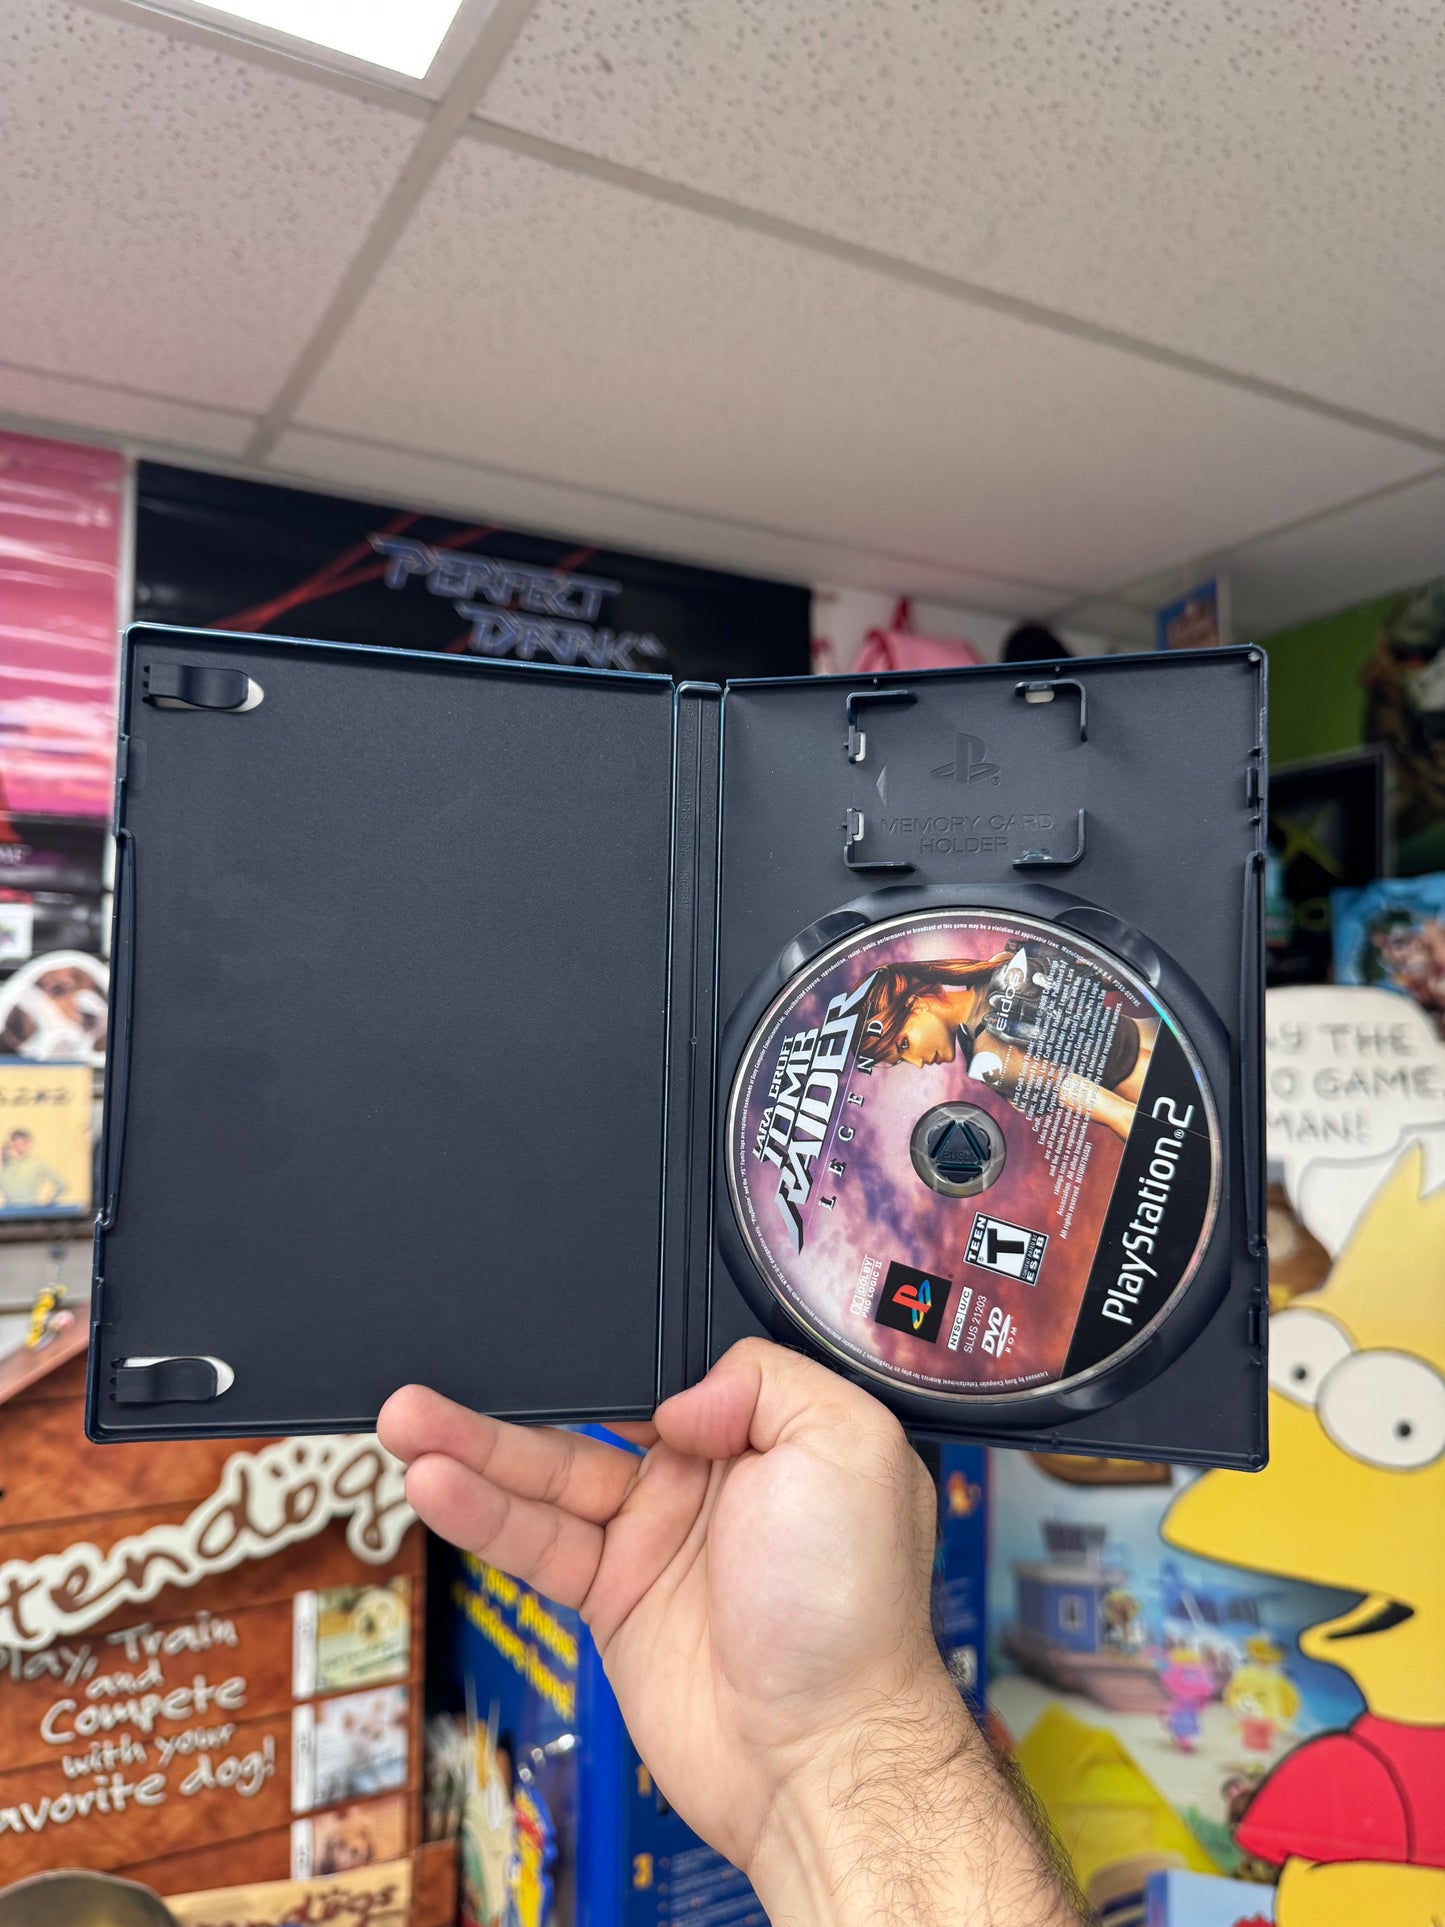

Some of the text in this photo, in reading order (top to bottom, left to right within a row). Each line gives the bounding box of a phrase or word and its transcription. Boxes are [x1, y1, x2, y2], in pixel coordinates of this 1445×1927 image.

[880, 813, 1054, 835] MEMORY CARD
[919, 836, 1009, 854] HOLDER
[875, 929, 906, 946] performance
[911, 924, 937, 933] broadcast
[991, 924, 1014, 935] violation
[1019, 930, 1047, 945] applicable
[861, 940, 878, 953] public
[1045, 939, 1060, 949] laws.
[819, 955, 849, 979] reproduction,
[1046, 959, 1059, 981] Design
[1064, 967, 1074, 982] Lara
[803, 975, 823, 994] copying,
[1057, 981, 1071, 1006] Legend,
[1088, 979, 1100, 999] Logic,
[1097, 988, 1106, 1000] The
[782, 989, 807, 1017] Unauthorized
[992, 970, 1020, 1032] eidos
[1085, 998, 1094, 1010] Pro
[1111, 1000, 1122, 1024] owners.
[777, 1013, 787, 1024] Inc.
[761, 1020, 782, 1050] Entertainment
[1018, 968, 1064, 1112] Ltd. Developed Crystal Inc. Published
[1047, 1027, 1057, 1044] Tomb
[1081, 1036, 1094, 1056] Dolby
[1101, 1023, 1117, 1055] respective
[1317, 1021, 1412, 1057] THE
[753, 1047, 768, 1069] Computer
[1031, 975, 1082, 1132] Croft, Tomb Raider, the Tomb Raider logo, Eidos and the
[1037, 977, 1092, 1145] Eidos logo, Crystal Dynamics and the Crystal Dynamics logo
[1042, 1043, 1053, 1059] Croft
[1097, 1054, 1107, 1069] their
[749, 1067, 759, 1080] Sony
[1019, 1060, 1029, 1077] Tomb
[1038, 1058, 1049, 1073] Lara
[1015, 1076, 1025, 1091] Croft
[1030, 1089, 1040, 1102] Inc.
[742, 1083, 754, 1109] trademarks
[751, 1034, 794, 1159] LARA CROFT
[760, 1027, 820, 1169] TOMB
[1011, 1091, 1020, 1105] Lara
[1052, 1005, 1111, 1196] ratings icon registered Entertainment Software
[739, 1107, 749, 1131] registered
[773, 968, 879, 1255] RAIDER
[817, 1017, 885, 1211] LEGEND
[1025, 1102, 1037, 1121] Eidos,
[1061, 1105, 1075, 1128] symbol
[1083, 1110, 1092, 1121] are
[1150, 1093, 1195, 1129] 2
[1048, 1107, 1063, 1140] trademarks
[738, 1138, 746, 1149] logo
[1045, 1140, 1054, 1149] all
[1054, 1126, 1067, 1154] double-D
[1073, 1120, 1089, 1154] trademarks
[738, 1149, 746, 1165] Family
[1043, 1149, 1051, 1160] are
[1051, 1153, 1060, 1165] the
[1068, 1154, 1079, 1171] other
[740, 1177, 748, 1186] the
[1047, 1164, 1057, 1176] and
[1066, 1170, 1075, 1180] All
[741, 1185, 749, 1194] and
[1056, 1179, 1072, 1215] Association.
[743, 1194, 758, 1225] "PlayStation"
[1059, 1183, 1081, 1239] All rights reserved.
[966, 1216, 987, 1262] TEEN
[987, 1227, 1024, 1264] T
[1025, 1235, 1045, 1282] ESRB
[856, 1258, 874, 1294] DOLBY
[861, 1259, 882, 1318] PRO LOGIC II
[948, 1289, 971, 1346] NTSC U/C
[962, 1293, 987, 1354] SLUS 21203
[979, 1305, 1007, 1355] DVD
[1004, 1325, 1018, 1353] ROM
[0, 1446, 408, 1639] tendog
[105, 1609, 239, 1663] Train
[85, 1658, 164, 1699] and
[40, 1675, 248, 1744] Compete
[62, 1722, 237, 1779] with your
[179, 1733, 276, 1797] dog!
